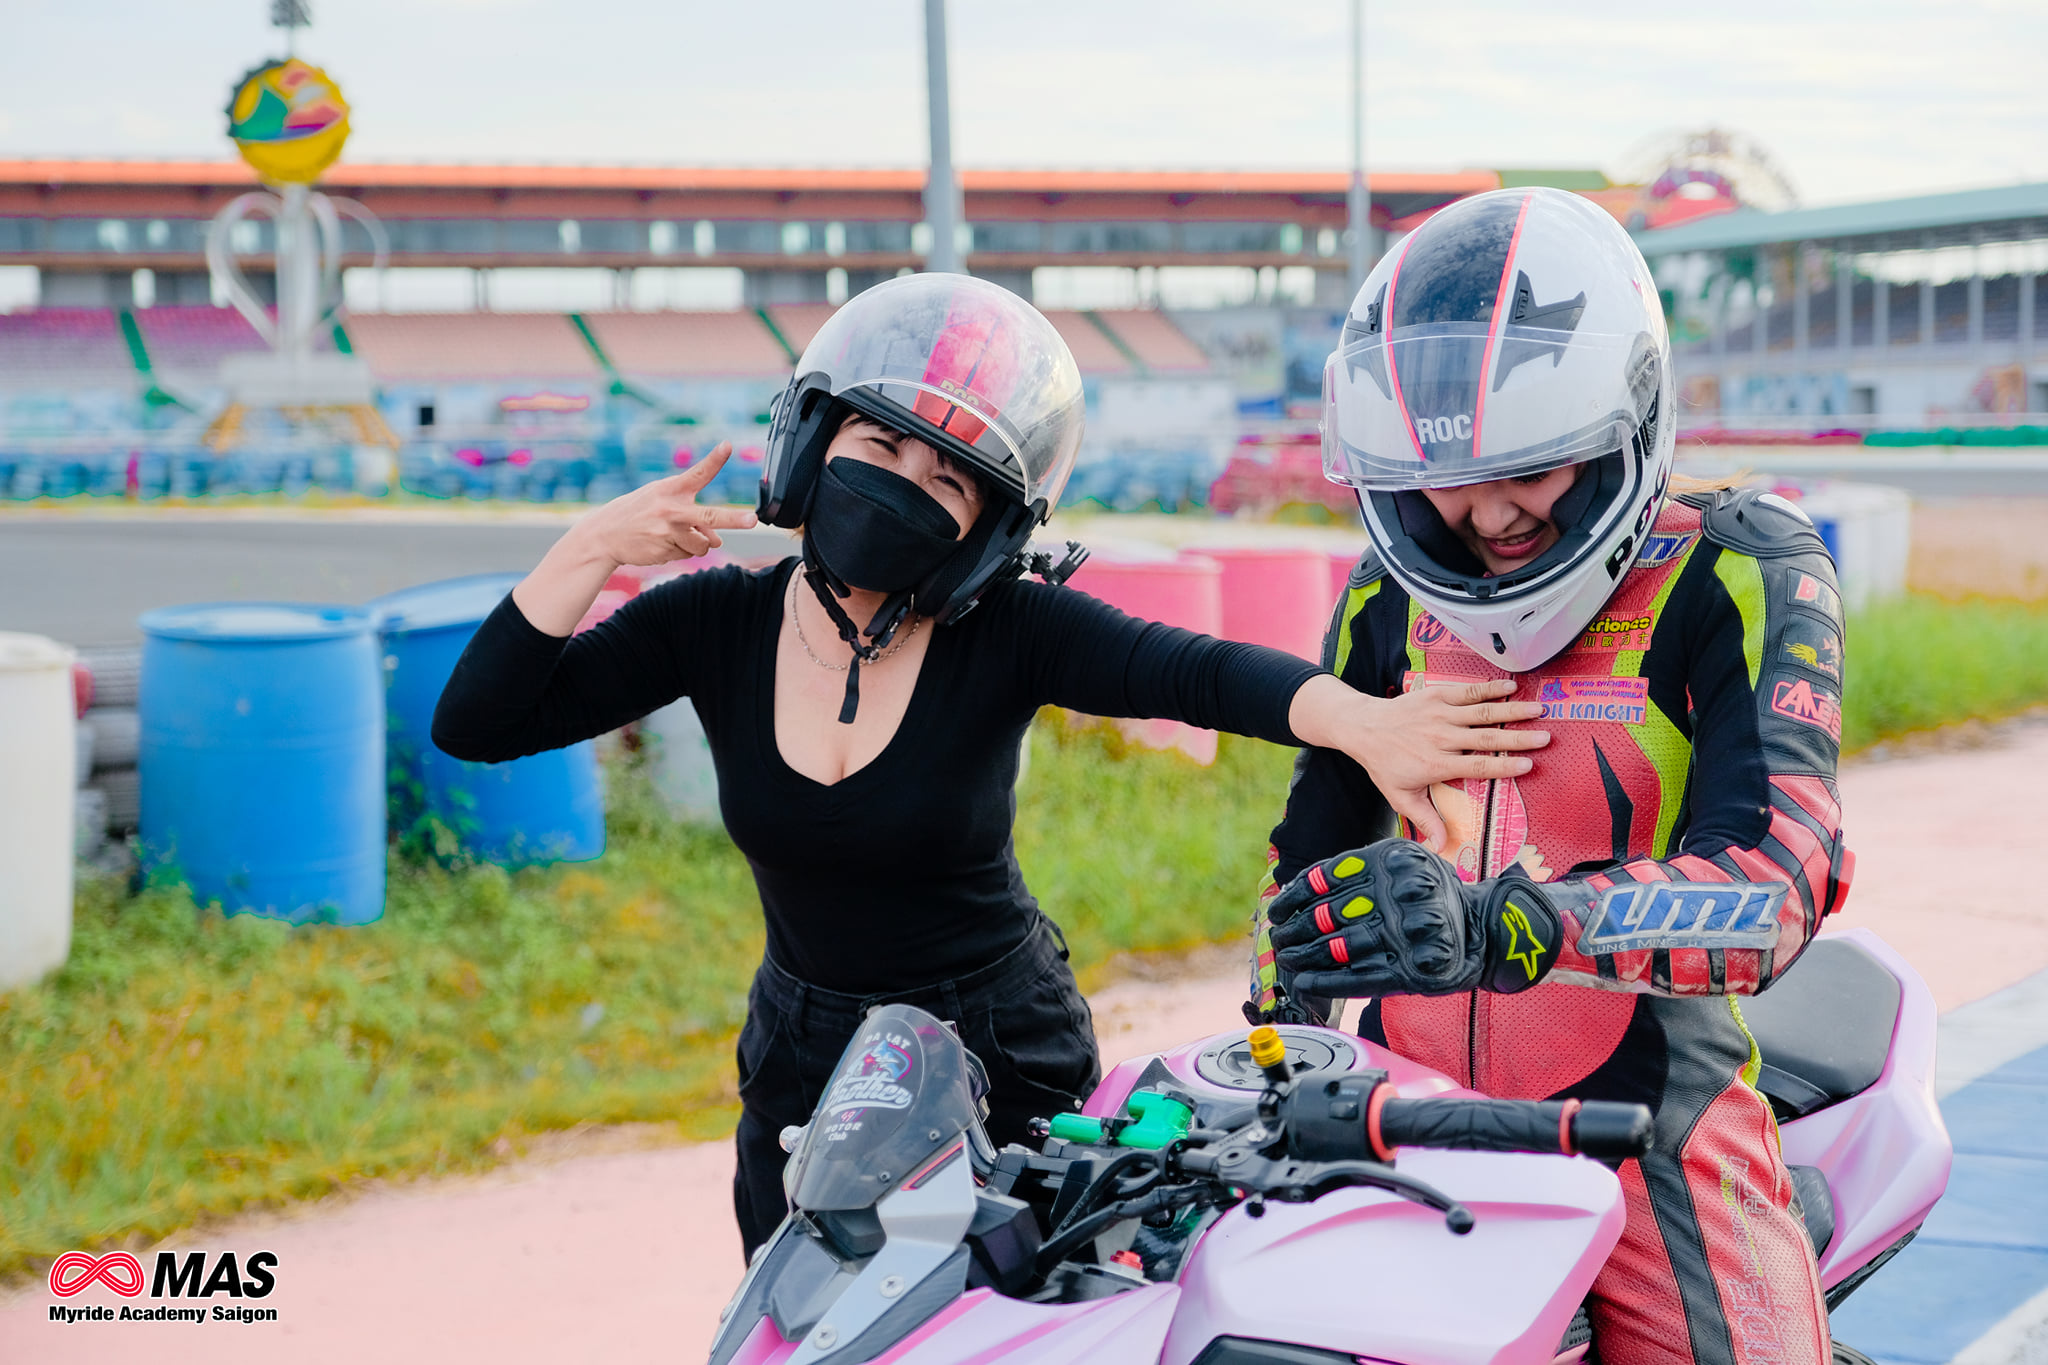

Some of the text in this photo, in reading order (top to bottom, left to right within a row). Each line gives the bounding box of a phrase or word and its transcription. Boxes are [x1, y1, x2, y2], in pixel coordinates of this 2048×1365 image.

[1416, 414, 1474, 444] ROC
[1590, 942, 1628, 955] LUNG
[1636, 937, 1679, 949] MING
